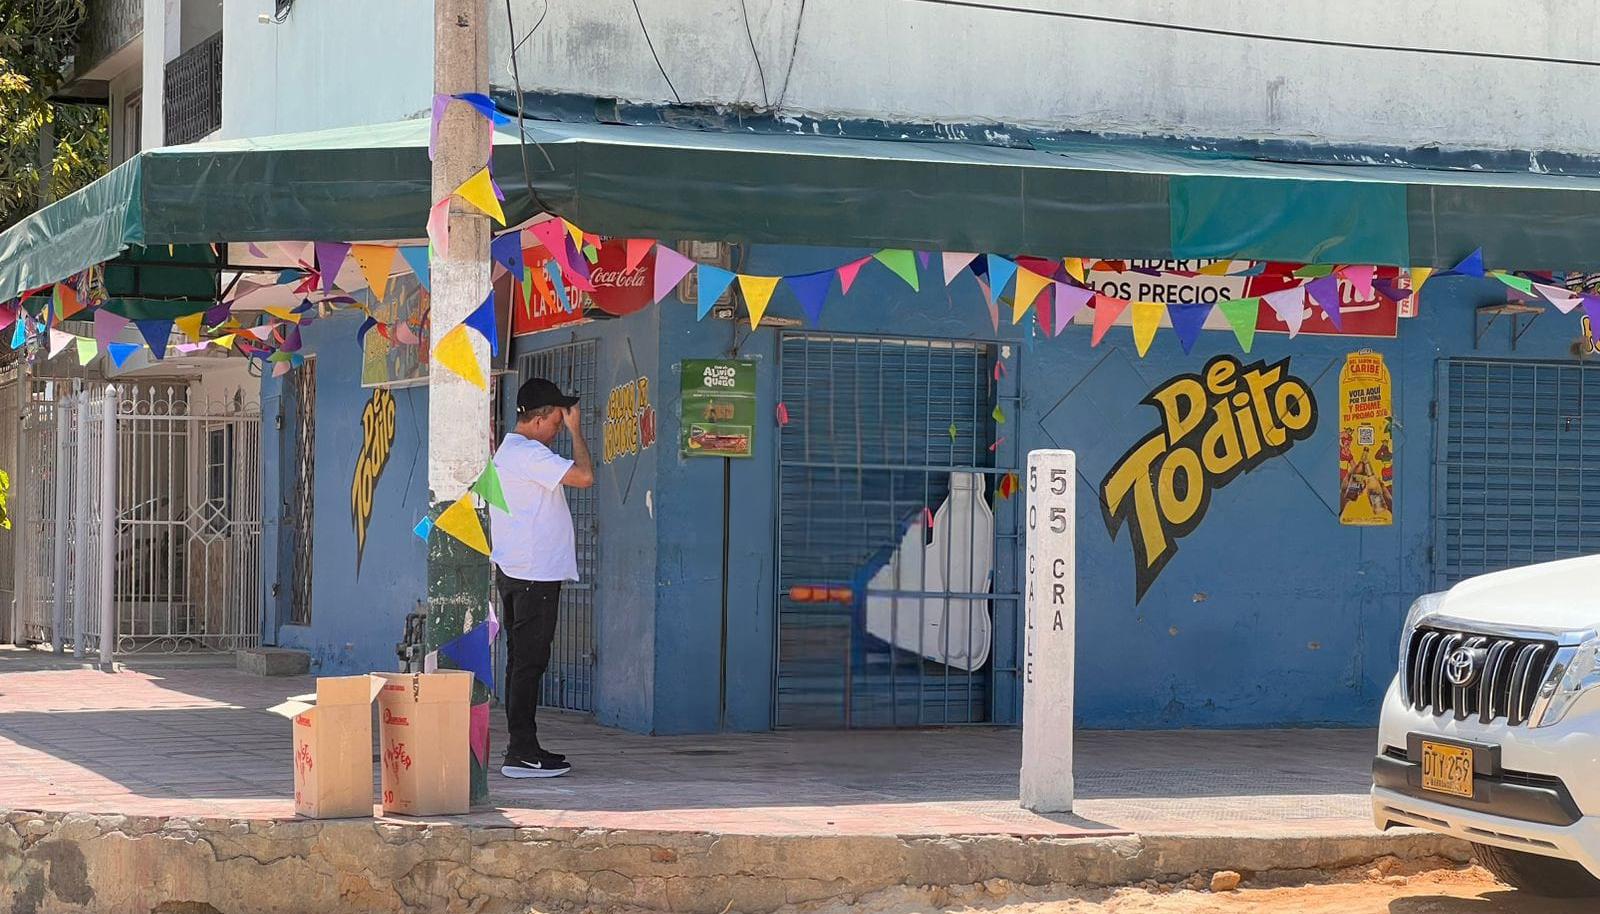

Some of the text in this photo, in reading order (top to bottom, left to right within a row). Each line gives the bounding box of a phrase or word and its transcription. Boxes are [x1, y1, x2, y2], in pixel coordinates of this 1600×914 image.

[589, 267, 648, 287] Coca-Cola
[533, 293, 547, 318] LA
[1139, 283, 1230, 304] PRECIOS
[1350, 364, 1380, 374] CARIBE
[1103, 362, 1313, 572] Todito
[1052, 558, 1066, 631] CRA
[1027, 554, 1035, 683] CALLE
